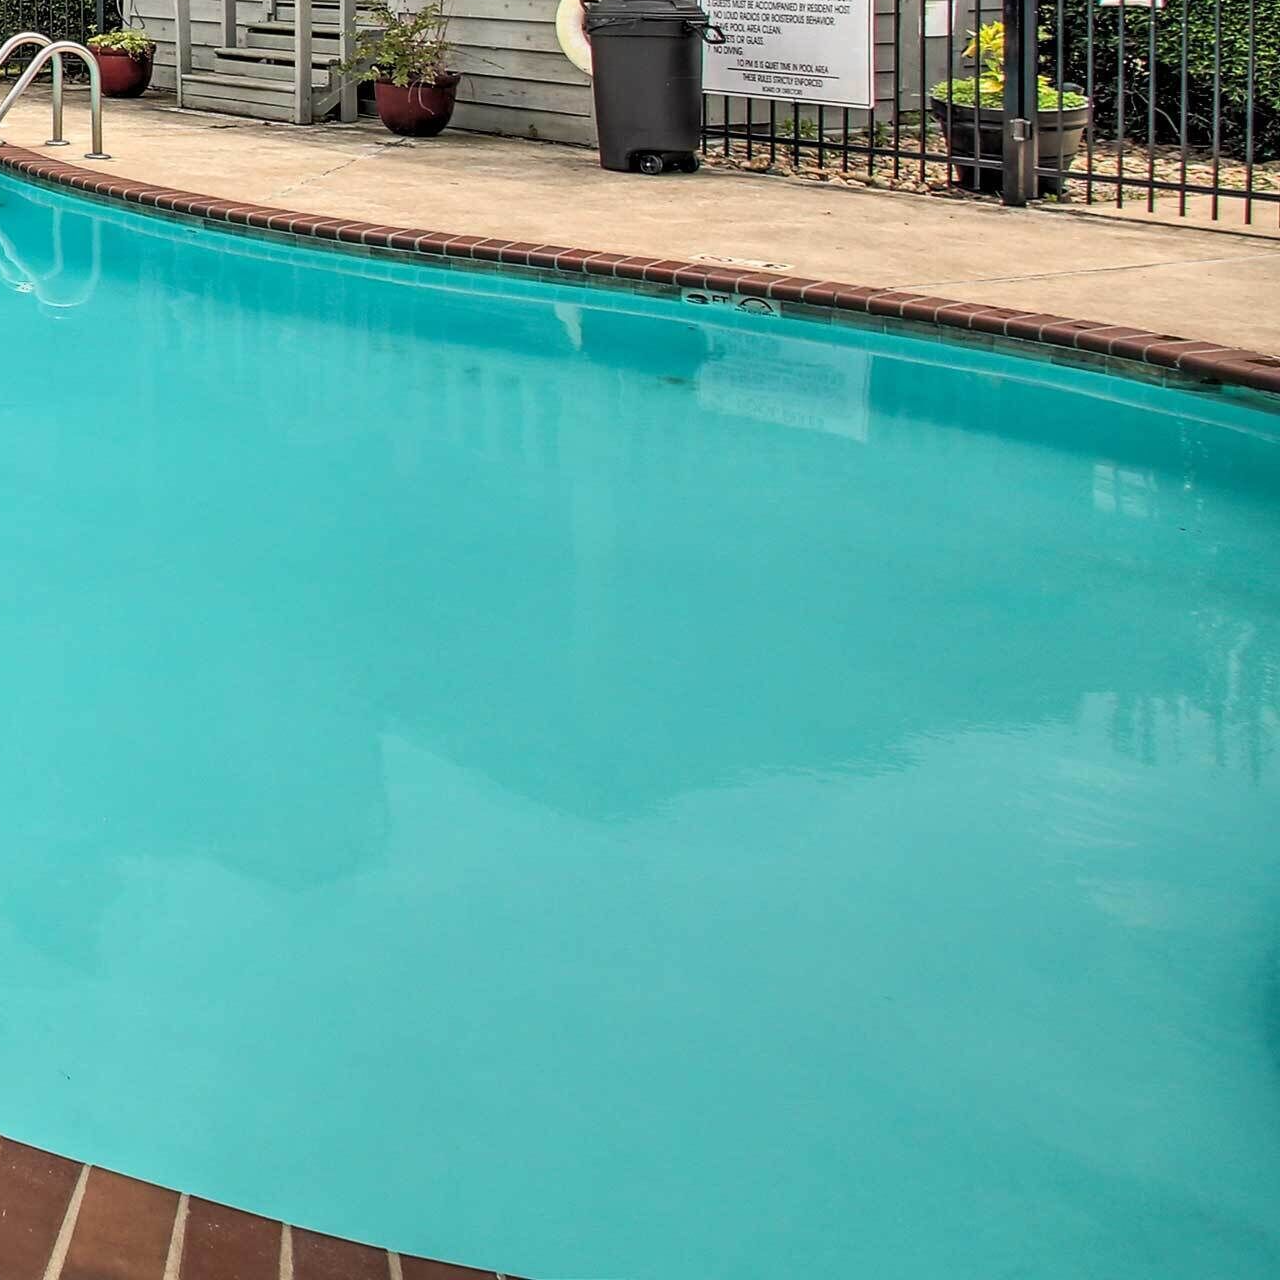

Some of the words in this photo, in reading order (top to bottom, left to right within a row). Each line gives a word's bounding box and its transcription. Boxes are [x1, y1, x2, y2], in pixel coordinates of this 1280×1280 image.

[732, 0, 746, 9] MUST
[747, 0, 754, 9] BE
[755, 1, 798, 12] ACCOMPANIED
[799, 3, 805, 12] BY
[807, 3, 833, 14] RESIDENT
[713, 10, 723, 19] NO
[723, 11, 738, 20] LOUD
[739, 12, 760, 22] RADIOS
[761, 13, 770, 22] OR
[771, 13, 805, 24] BOISTEROUS
[730, 23, 745, 32] POOL
[746, 24, 761, 34] AREA
[736, 35, 745, 44] OR
[713, 45, 723, 55] NO
[745, 59, 753, 68] PM
[764, 61, 779, 70] QUIET
[780, 62, 791, 71] TIME
[799, 64, 814, 73] POOL
[815, 65, 829, 74] AREA
[742, 73, 756, 82] THESE
[757, 74, 772, 83] RULES
[773, 75, 793, 85] STRICTLY
[794, 77, 823, 88] ENFORCED
